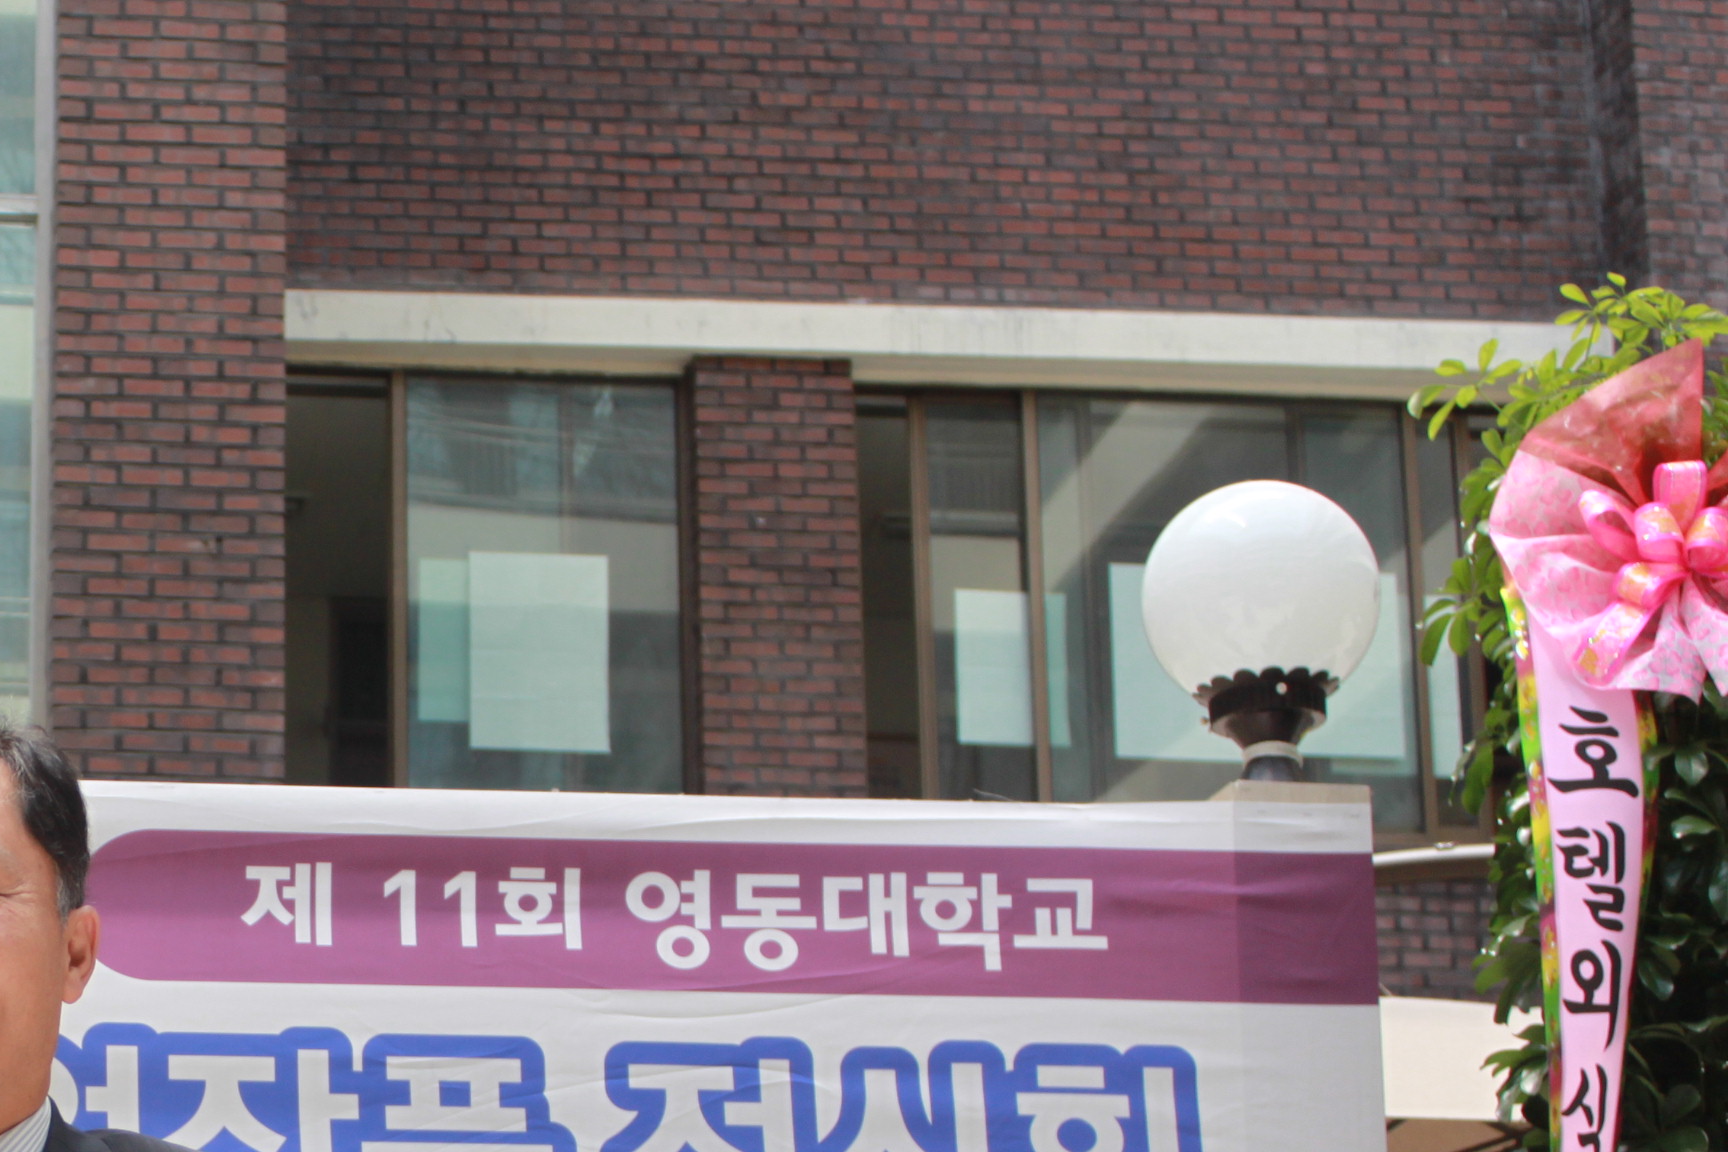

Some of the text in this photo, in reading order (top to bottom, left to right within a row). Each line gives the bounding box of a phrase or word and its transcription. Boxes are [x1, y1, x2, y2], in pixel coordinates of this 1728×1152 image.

[240, 861, 1110, 973] 제 11회 영동대학교
